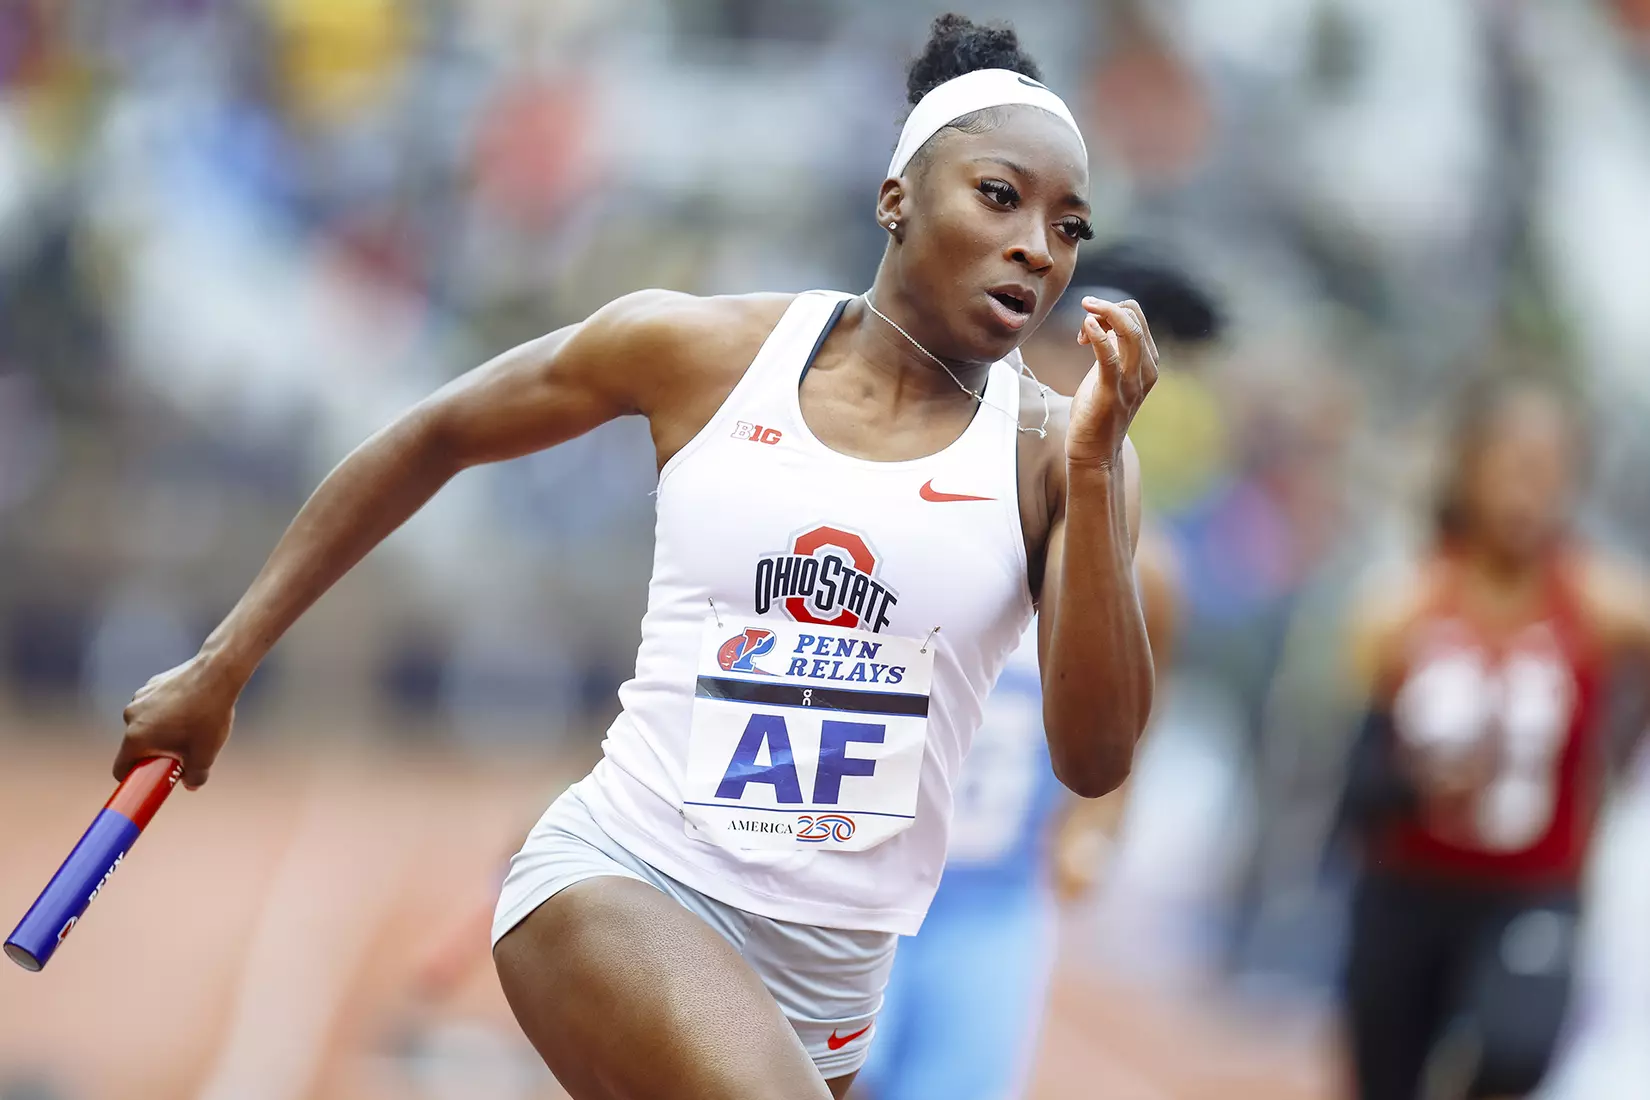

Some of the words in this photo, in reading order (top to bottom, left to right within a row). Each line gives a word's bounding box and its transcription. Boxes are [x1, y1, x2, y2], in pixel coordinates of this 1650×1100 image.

[755, 556, 819, 615] OHIO
[814, 554, 898, 634] STATE
[793, 633, 882, 660] PENN
[785, 656, 906, 685] RELAYS
[714, 713, 886, 805] AF
[727, 820, 793, 834] AMERICA
[796, 814, 856, 843] 250
